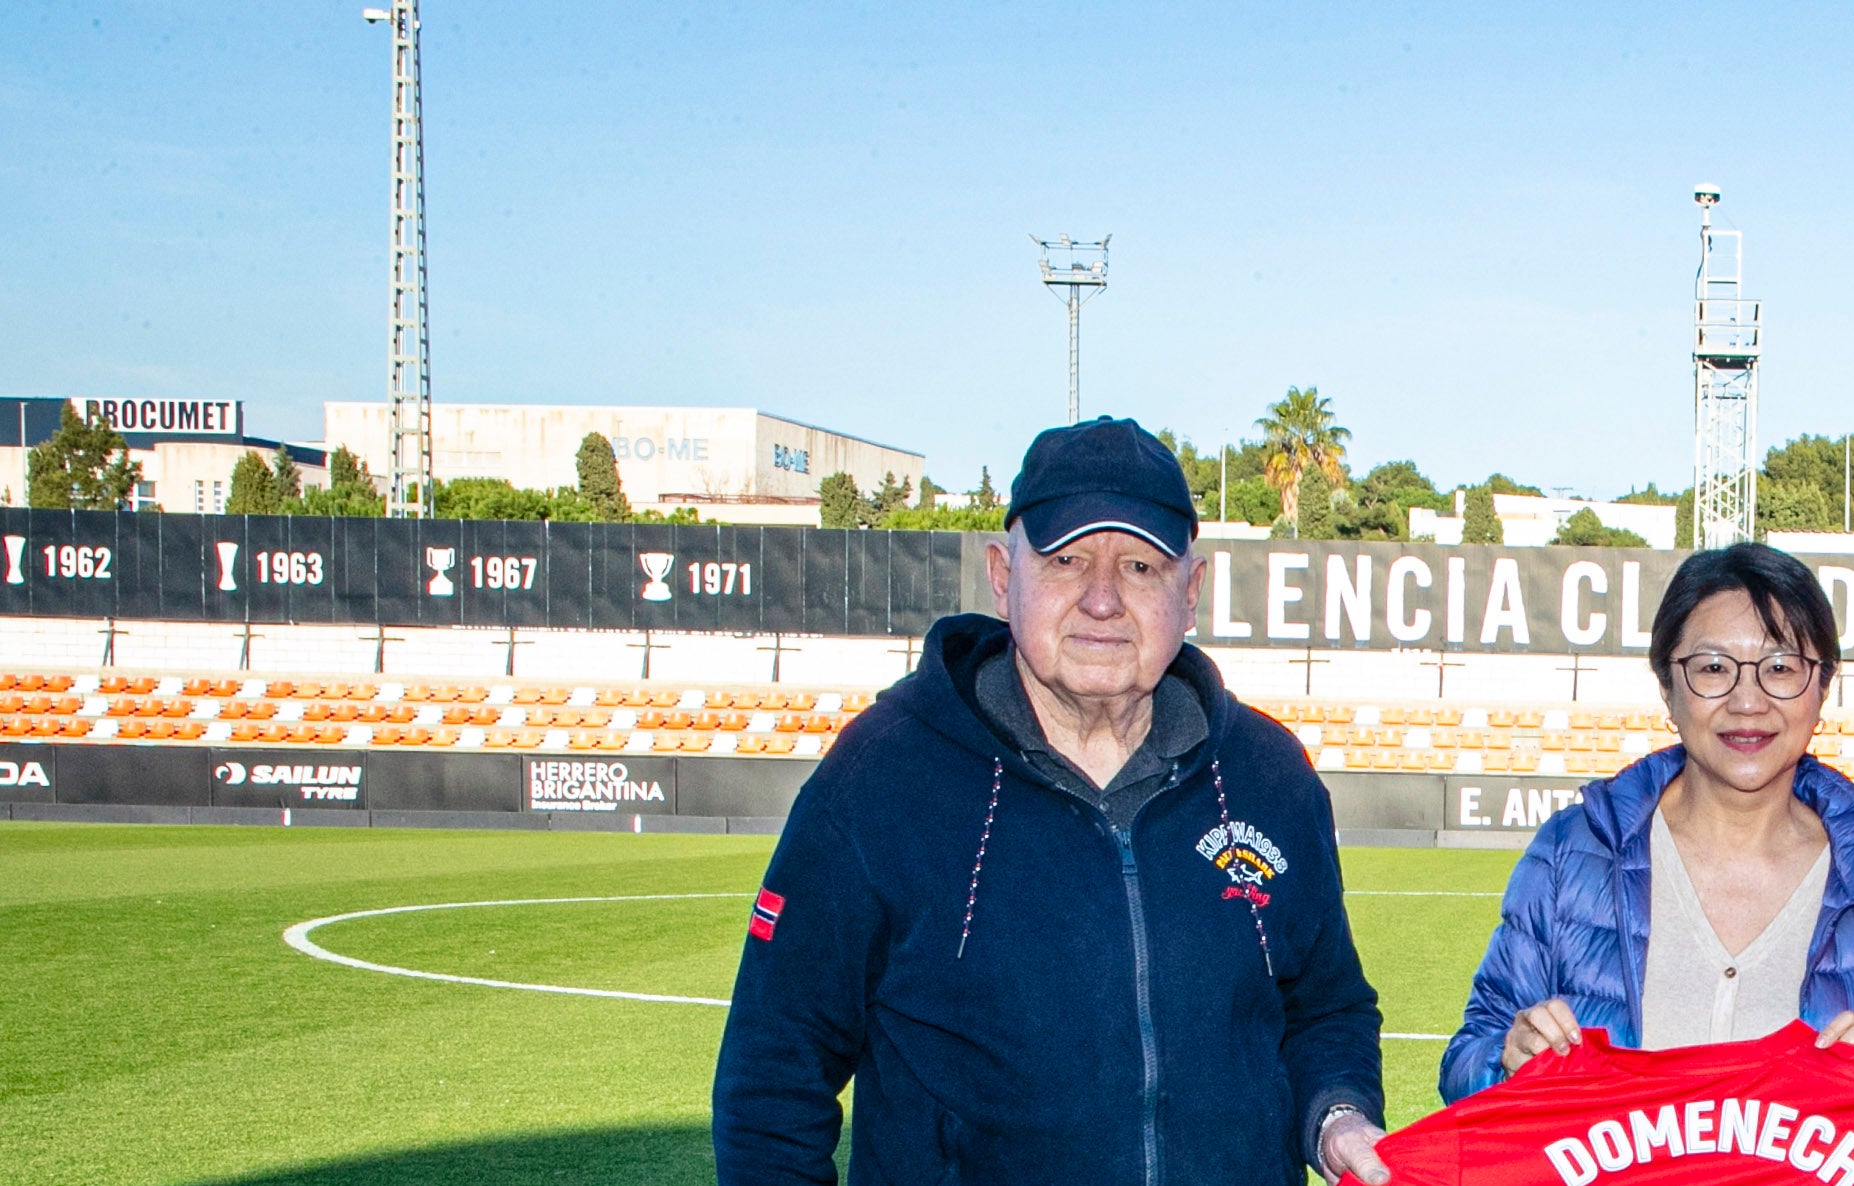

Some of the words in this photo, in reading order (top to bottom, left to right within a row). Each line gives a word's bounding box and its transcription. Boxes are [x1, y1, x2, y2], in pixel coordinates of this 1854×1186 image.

[44, 545, 111, 579] 1962
[257, 552, 324, 584] 1963
[471, 557, 537, 589] 1967
[689, 563, 751, 595] 1971
[1185, 551, 1530, 645] LENCIA
[1560, 560, 1653, 648] CL
[251, 765, 362, 785] SAILUN
[531, 762, 628, 782] HERRERO
[301, 786, 358, 800] TYRE
[531, 780, 664, 801] BRIGANTINA
[1460, 787, 1491, 826] E.
[1502, 788, 1584, 827] ANT
